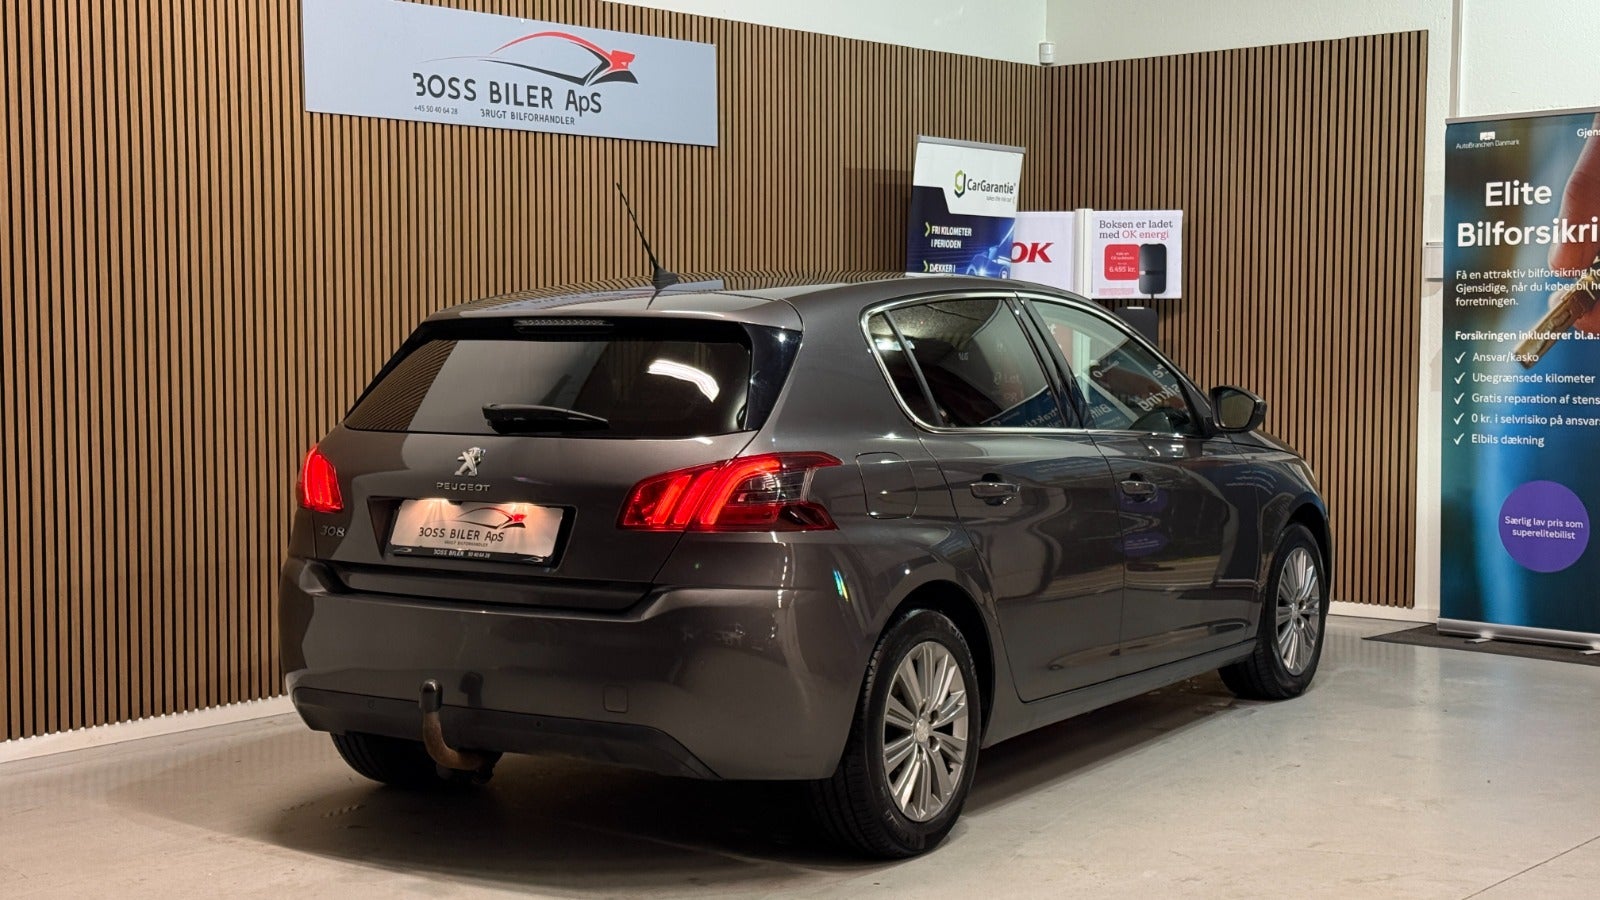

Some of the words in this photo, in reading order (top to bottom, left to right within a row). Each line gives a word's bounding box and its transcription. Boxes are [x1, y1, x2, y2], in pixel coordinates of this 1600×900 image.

[489, 81, 553, 109] BILER
[564, 89, 602, 117] ApS
[426, 105, 434, 113] 50
[435, 106, 442, 114] 40
[451, 107, 459, 115] 28
[510, 111, 576, 126] BILFORHANDLER
[1495, 139, 1520, 147] Danmark
[967, 178, 1014, 195] CarGarantie
[1485, 179, 1553, 207] Elite
[1099, 219, 1134, 229] Boksen
[1135, 221, 1147, 229] er
[1148, 219, 1174, 229] ladet
[931, 225, 941, 235] FRI
[941, 226, 973, 237] KILOMETER
[1099, 230, 1120, 240] med
[1122, 230, 1137, 239] OK
[1139, 229, 1169, 241] energi
[1457, 216, 1599, 248] Bilforsikri
[934, 239, 962, 249] PERIODEN
[1011, 242, 1054, 263] OK
[1456, 270, 1468, 280] Få
[1469, 271, 1481, 279] en
[1483, 269, 1526, 279] attraktiv
[1528, 267, 1588, 279] bilforsikring
[1456, 283, 1509, 295] Gjensidige,
[1511, 283, 1528, 292] når
[1530, 282, 1543, 291] du
[1545, 281, 1575, 292] køber
[1576, 281, 1589, 291] bil
[1456, 297, 1519, 308] forretningen.
[1455, 331, 1517, 342] Forsikringen
[1519, 331, 1573, 341] inkluderer
[1574, 331, 1600, 340] bl.a.:
[1472, 352, 1540, 363] Ansvar/kasko
[1472, 373, 1543, 385] Ubegrænsede
[1545, 373, 1596, 384] kilometer
[1471, 393, 1502, 404] Gratis
[1504, 394, 1558, 405] reparation
[1559, 395, 1570, 404] af
[1571, 396, 1600, 405] stens
[1471, 414, 1478, 424] 0
[1480, 414, 1493, 424] kr.
[1495, 415, 1499, 424] i
[1500, 414, 1548, 425] selvrisiko
[1549, 415, 1563, 427] på
[1565, 417, 1600, 426] ansvar
[1471, 434, 1498, 444] Elbils
[1500, 436, 1545, 447] dækning
[436, 482, 491, 492] PEUGEOT
[1504, 516, 1532, 527] Særlig
[1533, 517, 1545, 526] lav
[1547, 519, 1563, 529] pris
[1565, 520, 1584, 528] som
[320, 524, 346, 537] 308
[449, 528, 480, 541] BILER
[484, 530, 505, 543] ApS
[1512, 528, 1576, 540] superelitebilist
